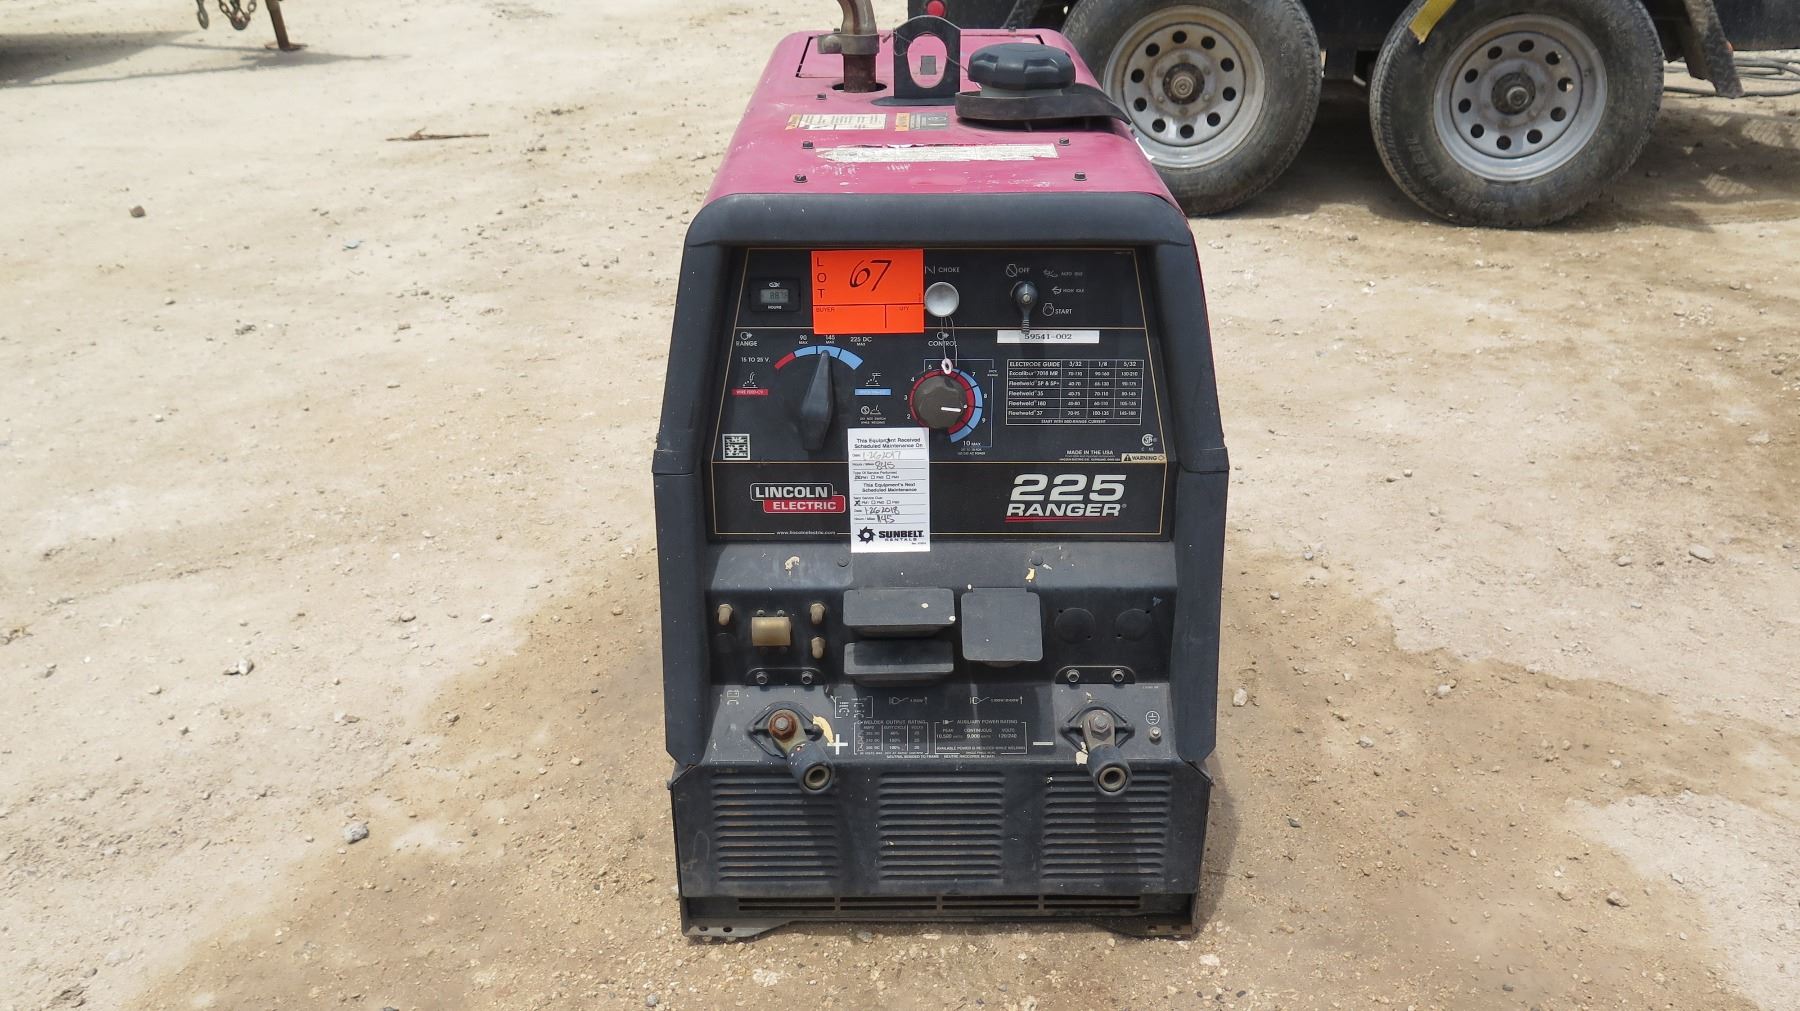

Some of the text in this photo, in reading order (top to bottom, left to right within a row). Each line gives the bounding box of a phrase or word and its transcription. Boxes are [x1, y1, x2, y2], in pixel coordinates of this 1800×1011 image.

[849, 259, 893, 292] 67
[1024, 333, 1073, 341] 59541-002
[755, 486, 828, 498] LINCOLN
[1010, 473, 1127, 502] 225
[772, 501, 837, 510] ELECTRIC
[1006, 503, 1121, 517] RANGER
[878, 530, 924, 539] SUNBELT
